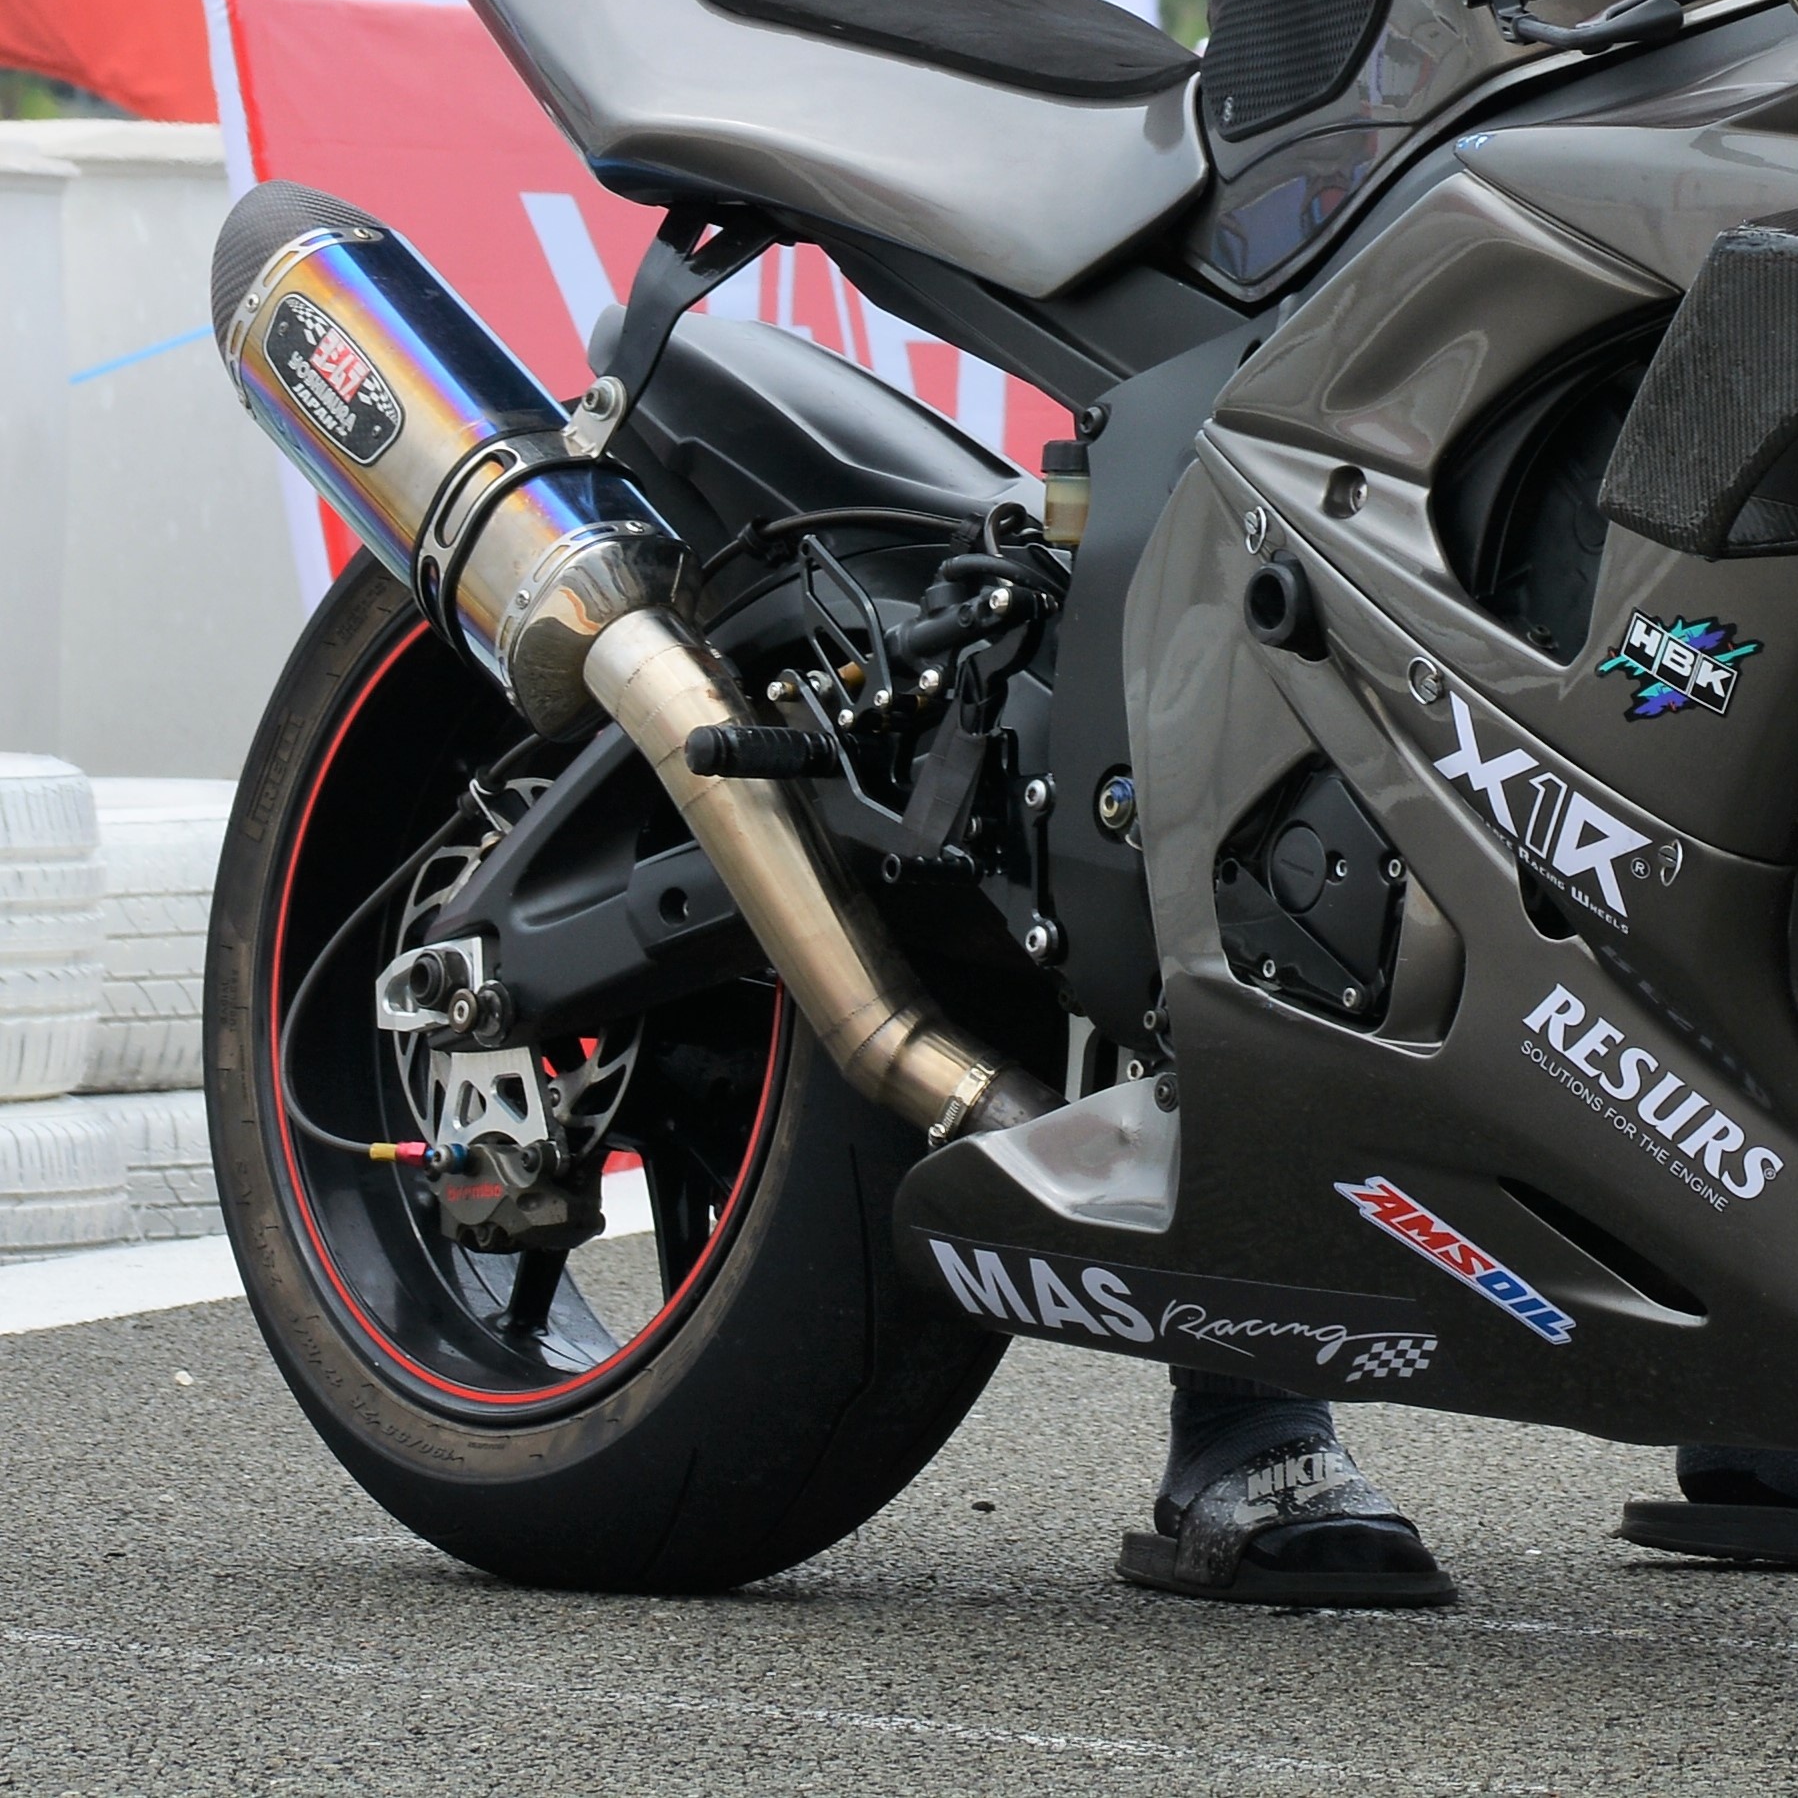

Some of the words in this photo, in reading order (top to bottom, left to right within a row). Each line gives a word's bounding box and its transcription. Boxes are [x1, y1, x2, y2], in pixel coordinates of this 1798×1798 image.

[288, 351, 357, 432] YOSHIMURA
[293, 383, 338, 431] JAPAN
[1629, 622, 1731, 698] HBK
[240, 709, 306, 844] PIRELLI
[1433, 690, 1653, 918] X1R
[1518, 845, 1566, 892] RACING
[1571, 885, 1630, 936] WHEELS
[1520, 1040, 1604, 1115] SOLUTIONS
[1604, 1108, 1638, 1141] FOR
[1638, 1133, 1670, 1165] THE
[1668, 1159, 1730, 1213] ENGINE
[1522, 983, 1784, 1200] RESURS
[928, 1238, 1156, 1344] MAS
[1345, 1180, 1577, 1344] AMSOIL
